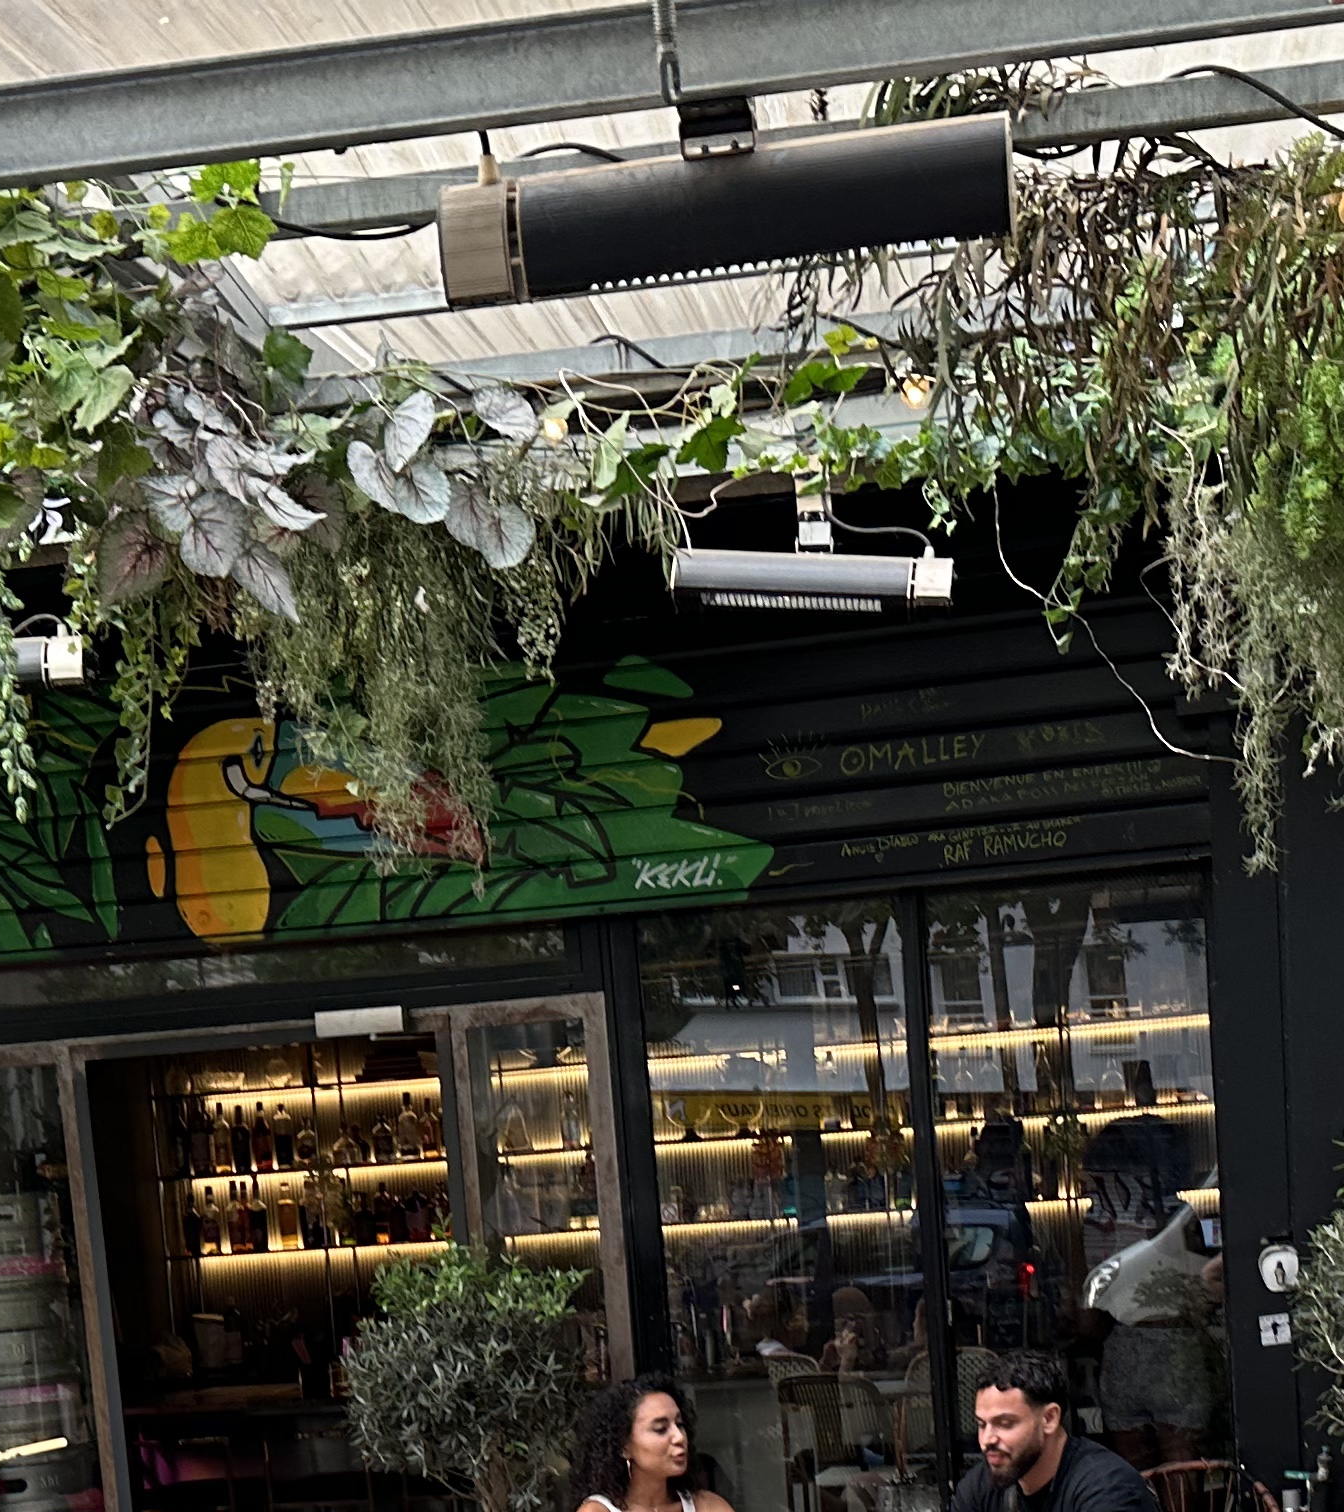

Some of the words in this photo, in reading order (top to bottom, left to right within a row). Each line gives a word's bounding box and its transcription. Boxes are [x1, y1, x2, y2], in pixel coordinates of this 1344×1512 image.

[840, 734, 986, 775] OMALLEY
[943, 773, 1037, 798] BIENVENUE
[943, 838, 973, 866] RAF
[983, 830, 1067, 858] RAMUCHO
